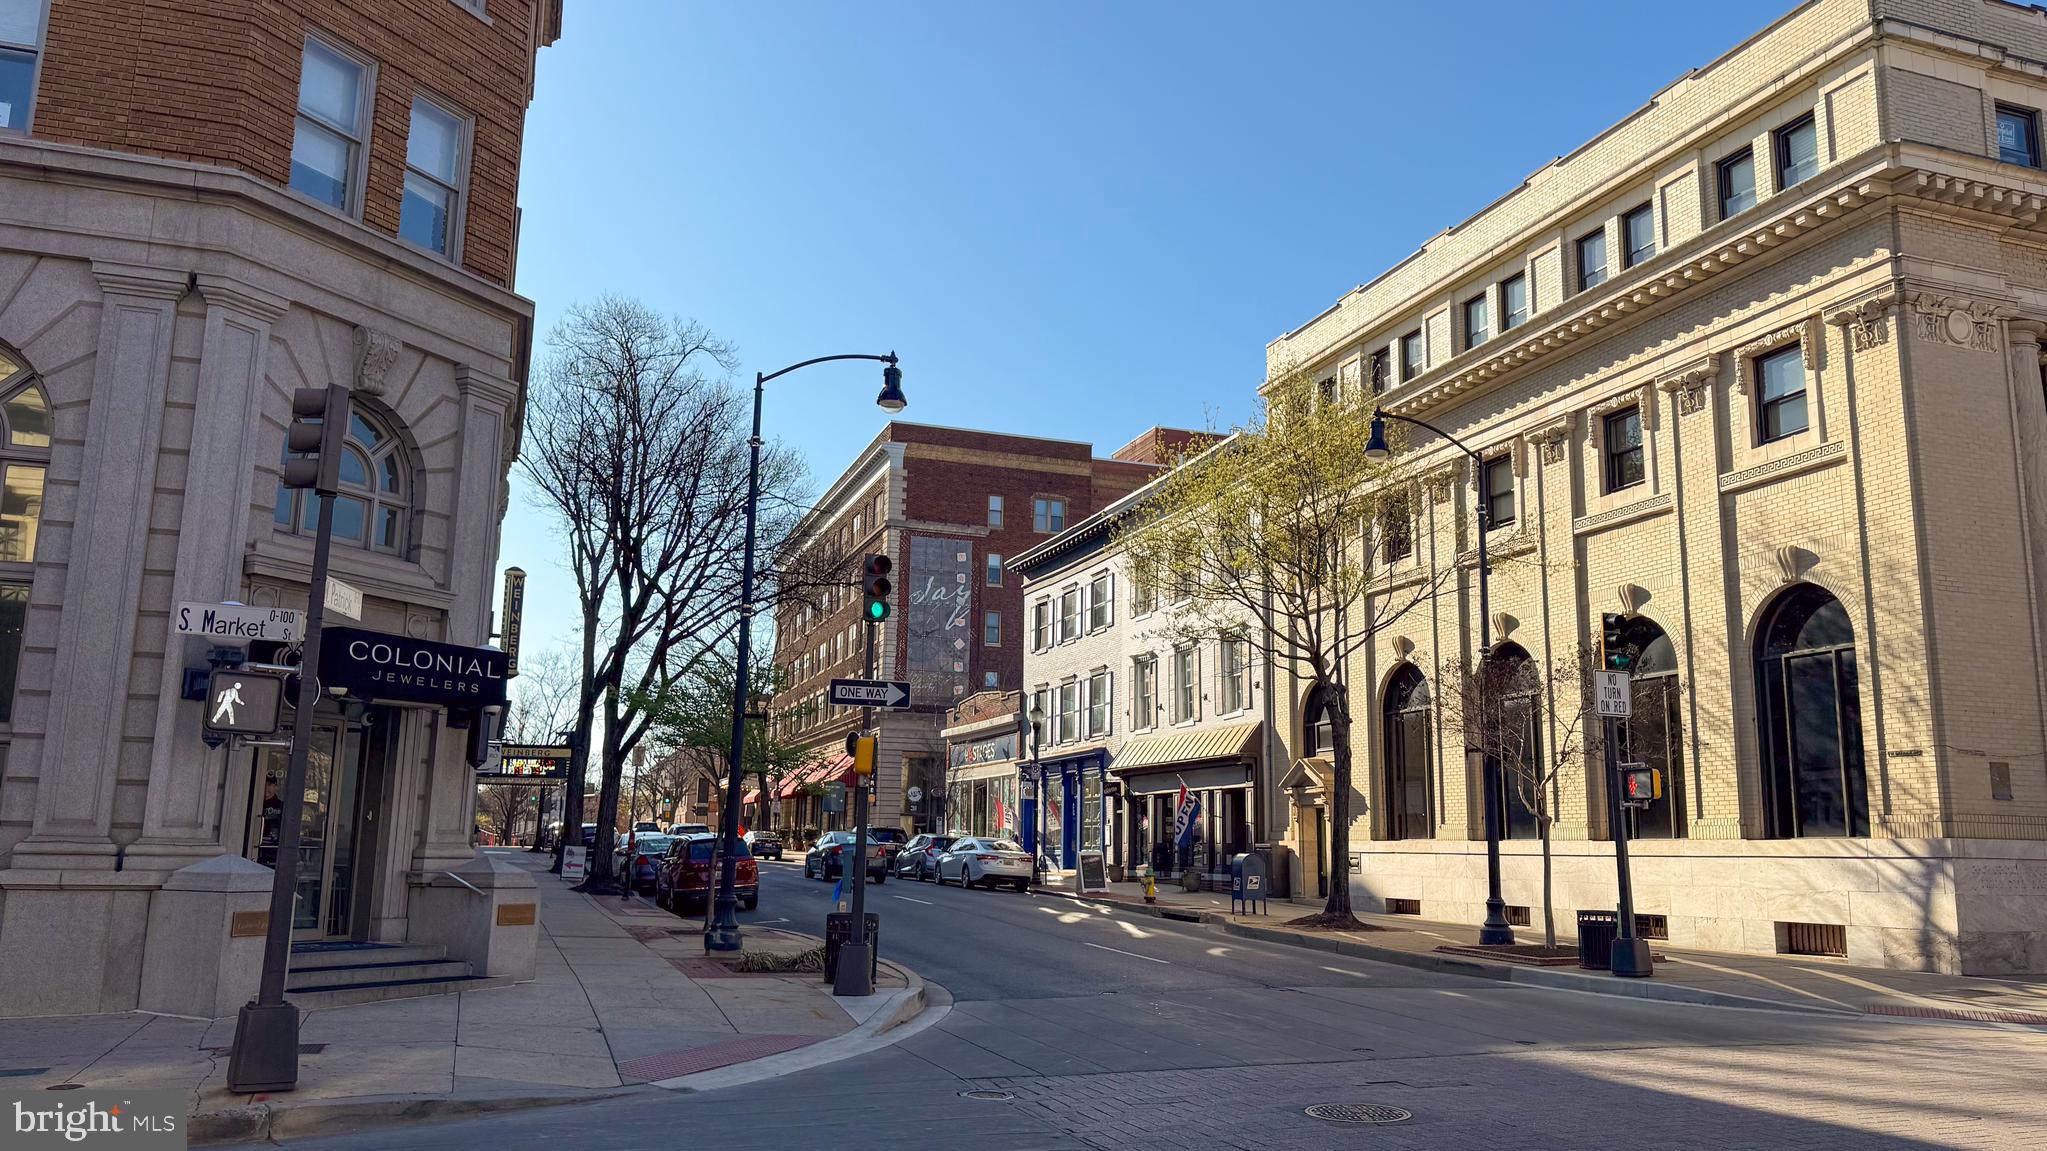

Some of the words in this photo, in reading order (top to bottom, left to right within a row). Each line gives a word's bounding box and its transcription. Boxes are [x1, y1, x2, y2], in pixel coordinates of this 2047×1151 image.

[178, 607, 193, 632] S.
[202, 609, 266, 638] Market
[269, 609, 295, 624] 0-100
[508, 576, 525, 668] WEINBERG
[282, 628, 292, 641] St
[349, 640, 501, 679] COLONIAL
[371, 670, 480, 693] JEWELERS
[1608, 674, 1617, 686] NO
[840, 686, 862, 698] ONE
[866, 687, 889, 699] WAY
[1604, 687, 1621, 699] TURN
[1600, 700, 1610, 712] ON
[1613, 701, 1626, 713] RED
